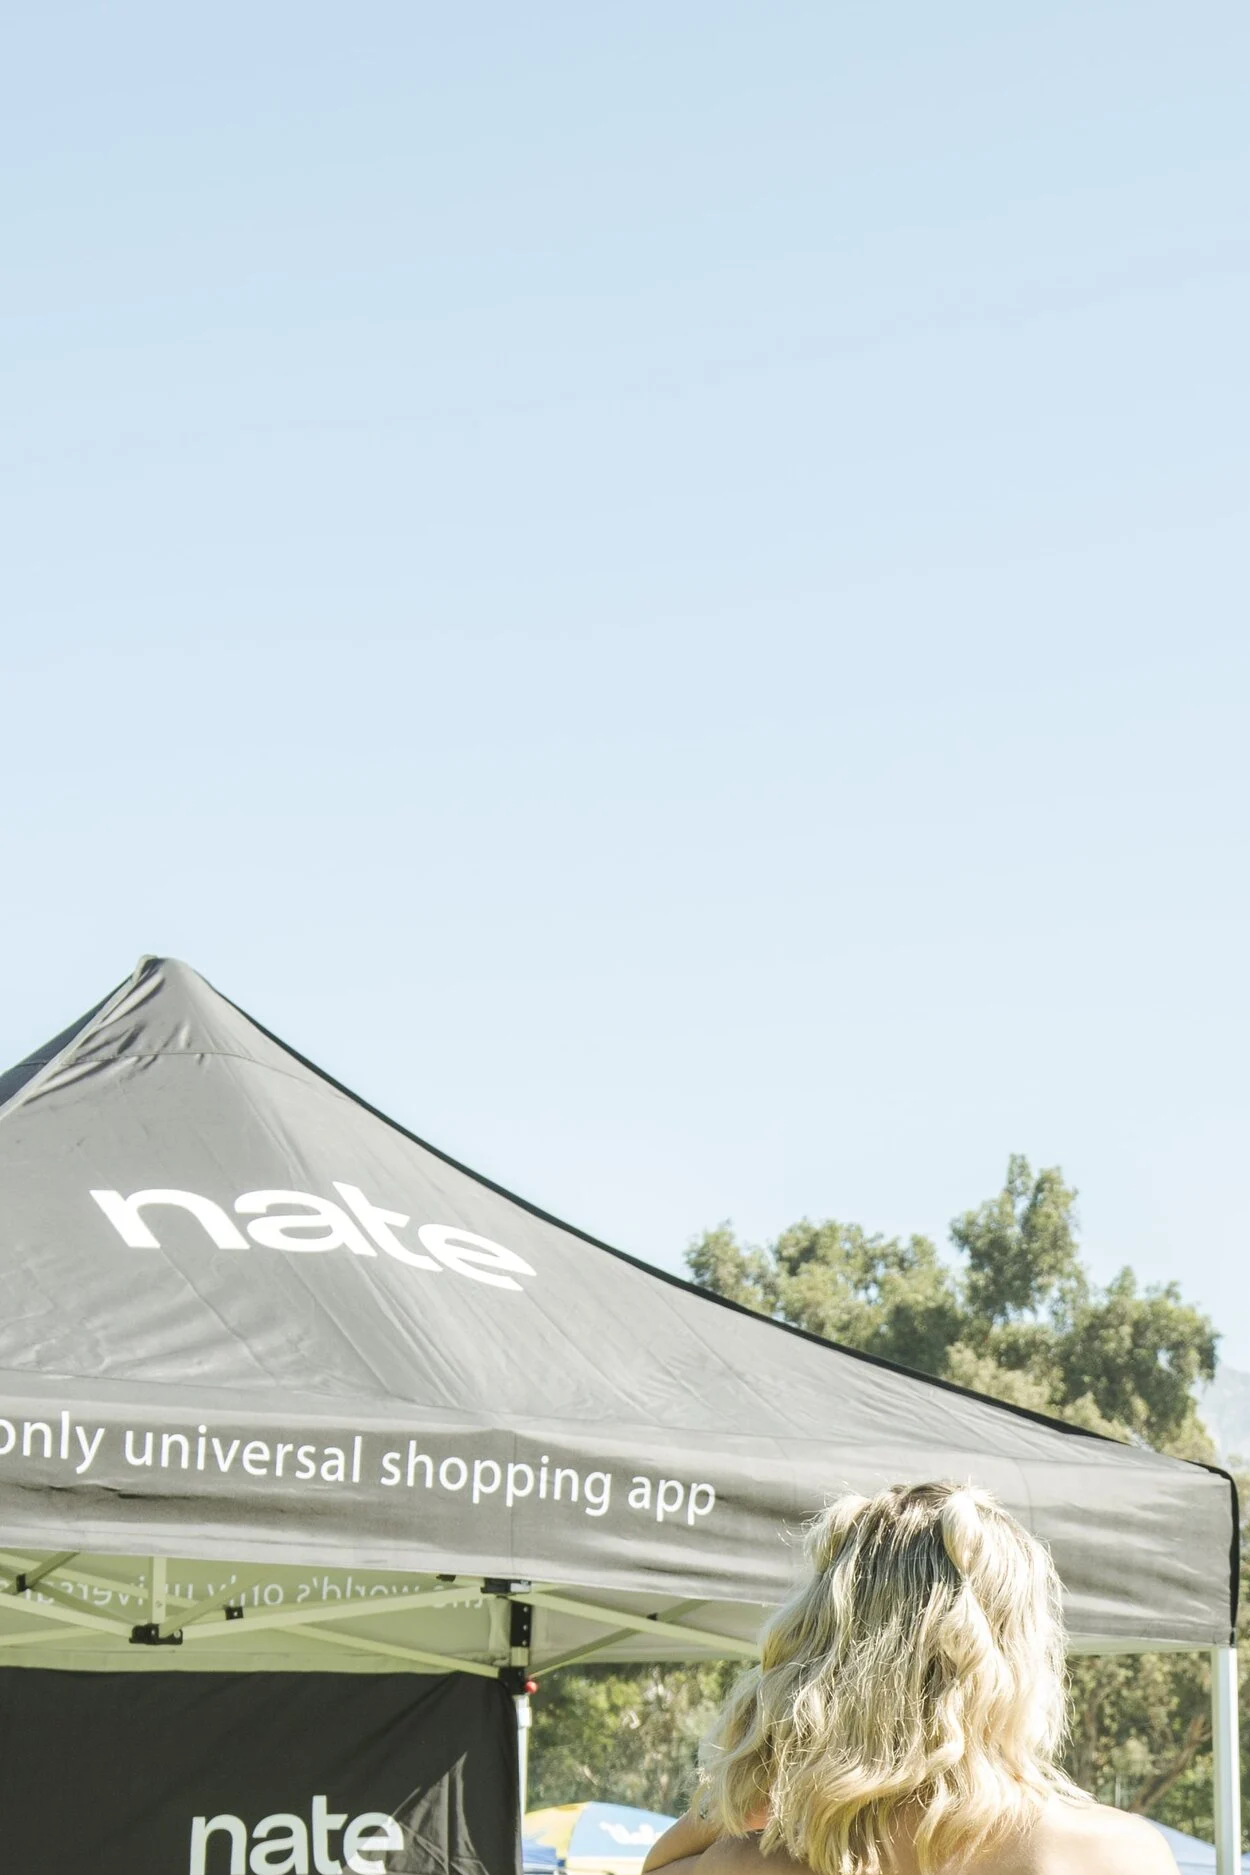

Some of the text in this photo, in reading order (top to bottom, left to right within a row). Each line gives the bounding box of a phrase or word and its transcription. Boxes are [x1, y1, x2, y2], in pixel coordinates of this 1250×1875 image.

[89, 1180, 537, 1291] nate
[0, 1410, 716, 1525] only universal shopping app
